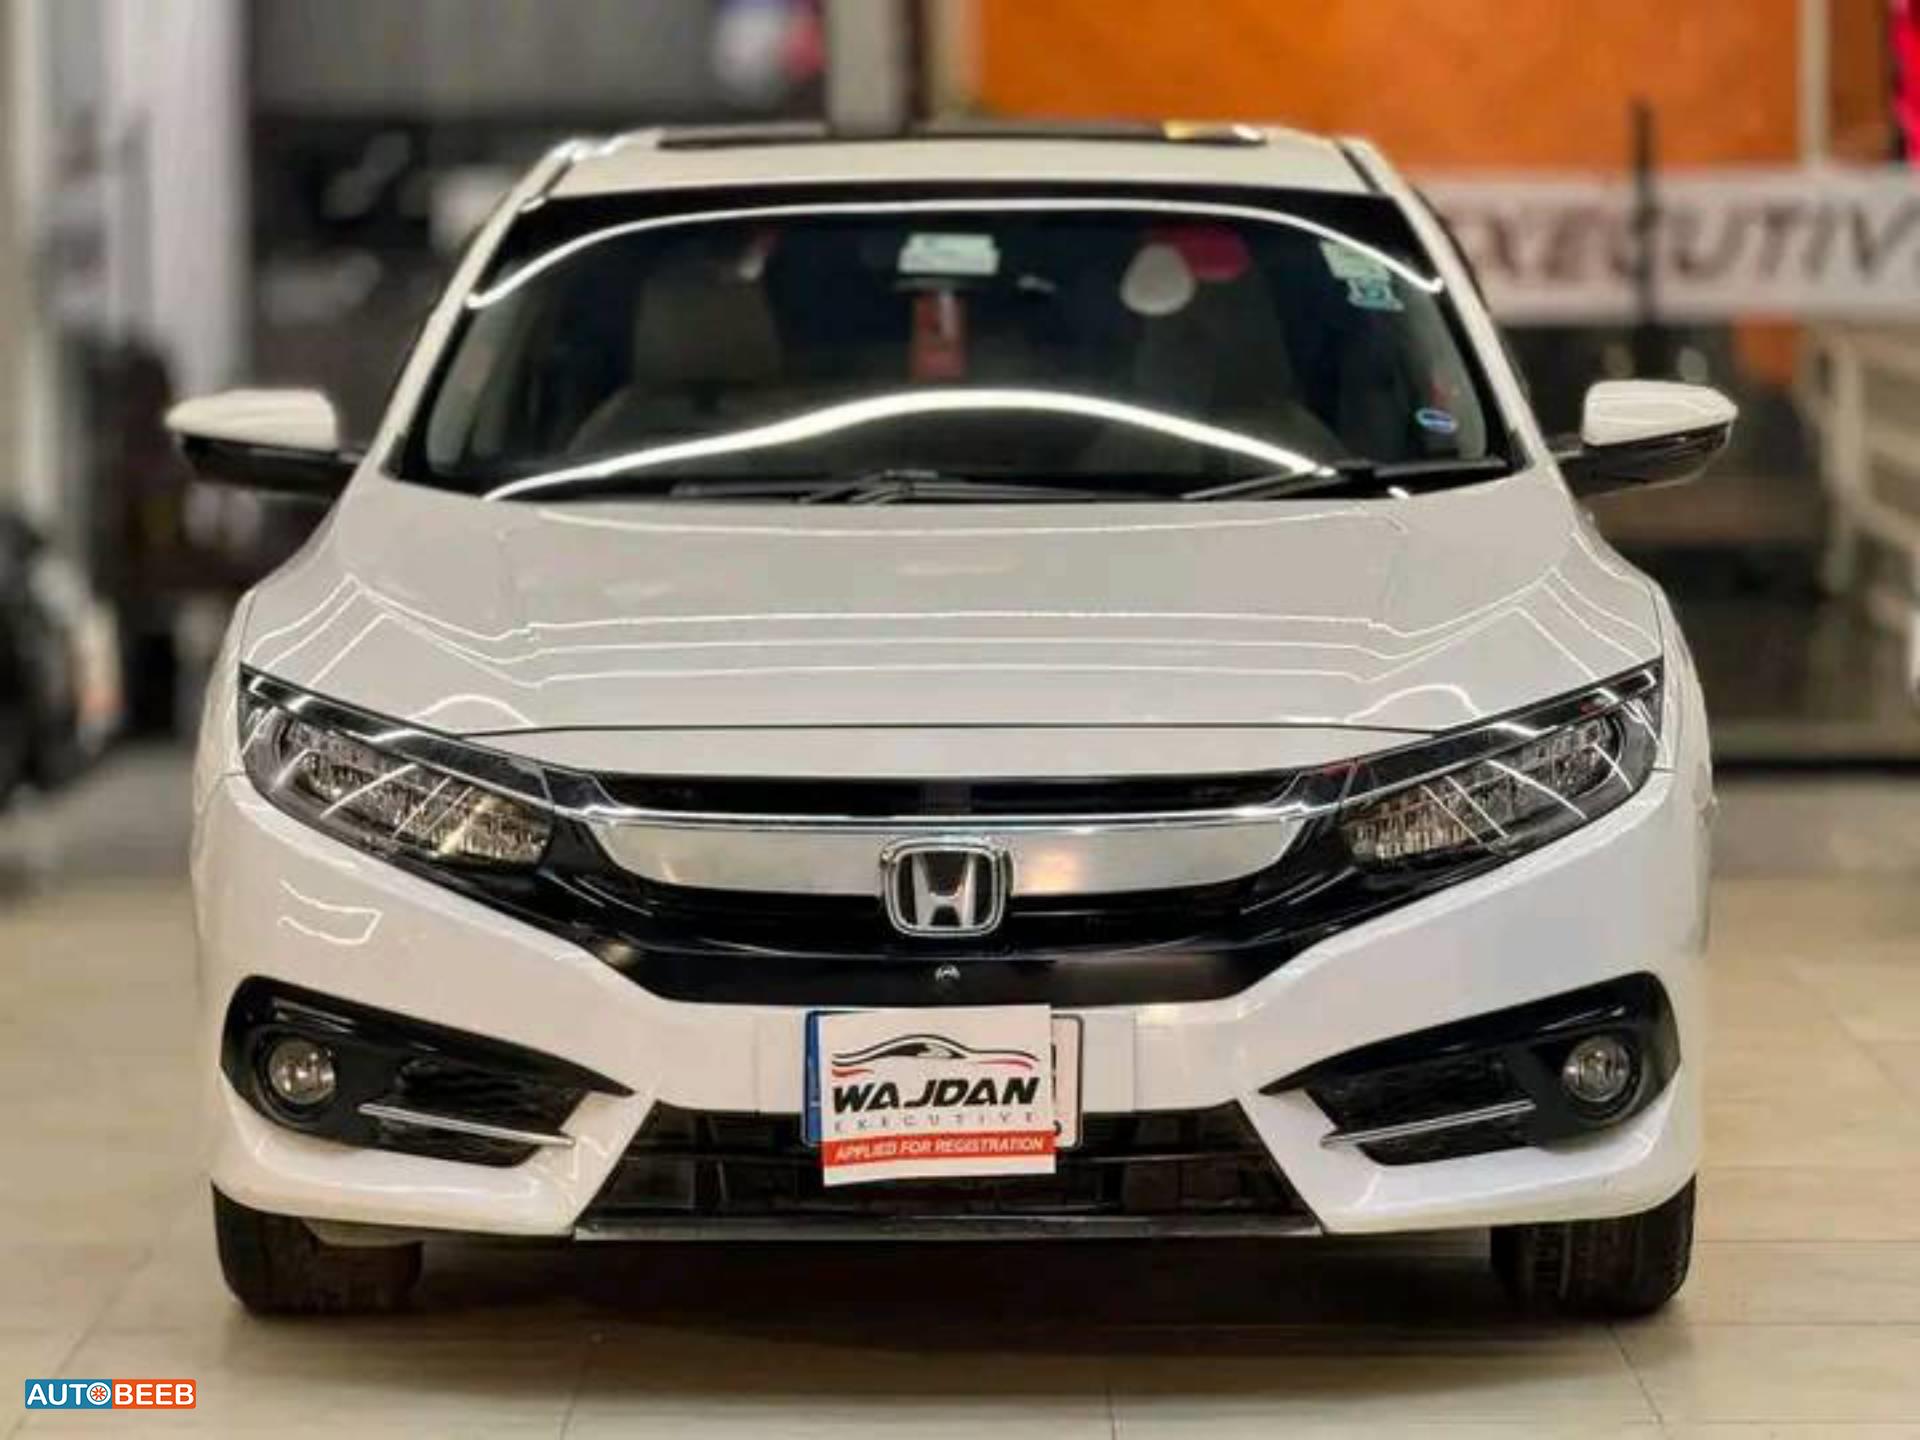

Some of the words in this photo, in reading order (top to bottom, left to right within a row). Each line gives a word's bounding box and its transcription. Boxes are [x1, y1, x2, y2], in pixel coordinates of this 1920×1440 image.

[832, 1077, 1040, 1114] WAJDAN
[835, 1141, 897, 1161] APPLIED
[899, 1138, 935, 1154] FOR
[936, 1136, 1044, 1154] REGISTRATION
